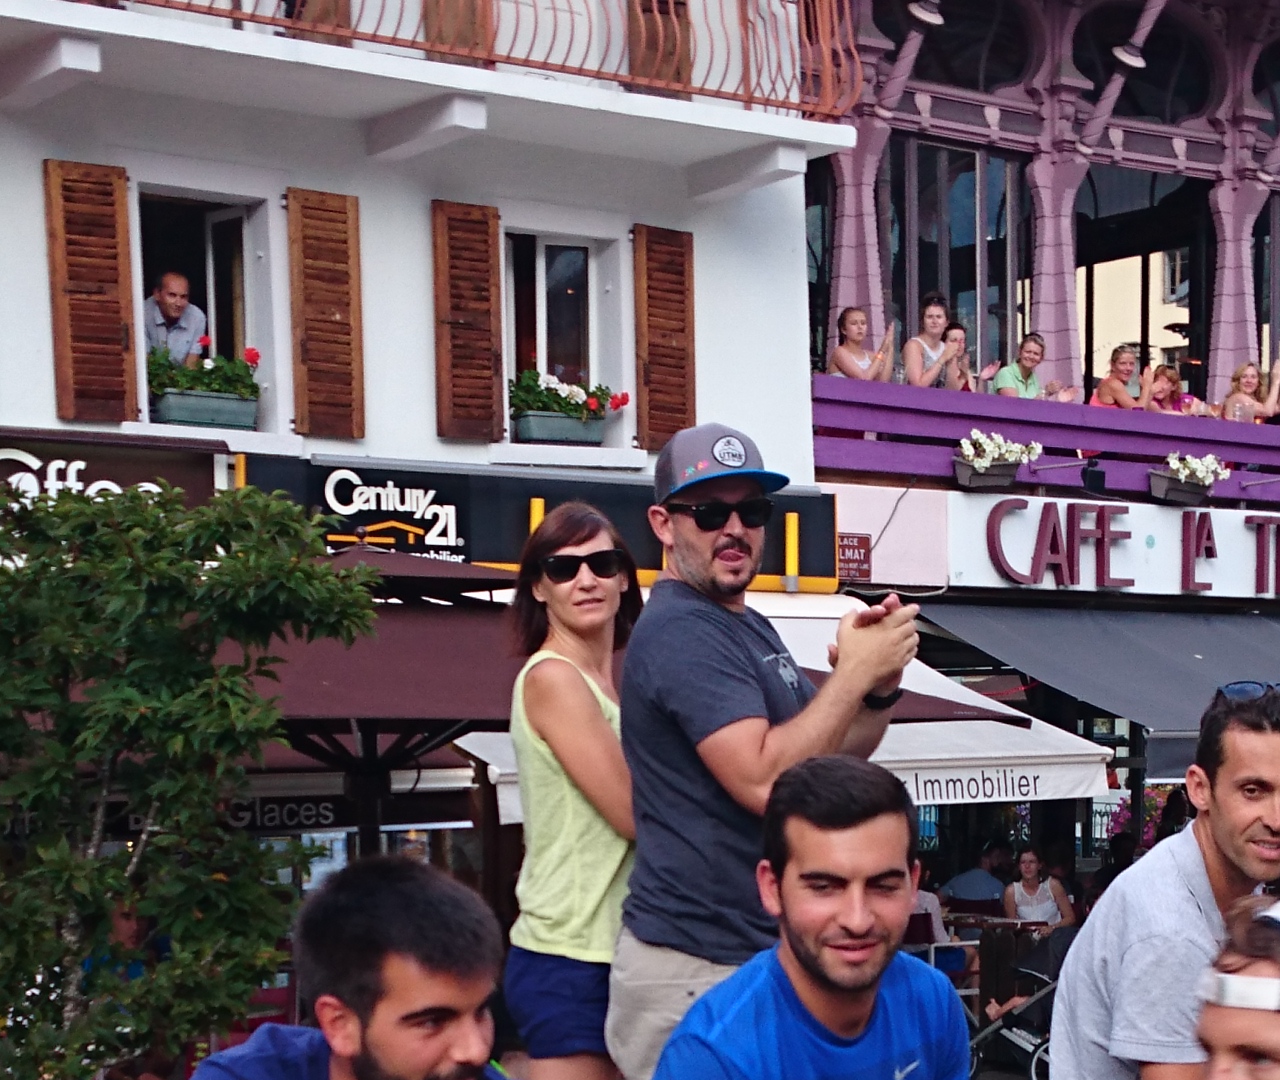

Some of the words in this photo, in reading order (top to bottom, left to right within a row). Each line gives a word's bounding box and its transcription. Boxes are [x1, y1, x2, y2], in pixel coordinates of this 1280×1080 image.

[325, 469, 436, 519] Century
[987, 497, 1135, 588] CAFE
[1181, 510, 1218, 592] LA
[914, 768, 1041, 802] Immobilier
[226, 797, 336, 829] Glaces
